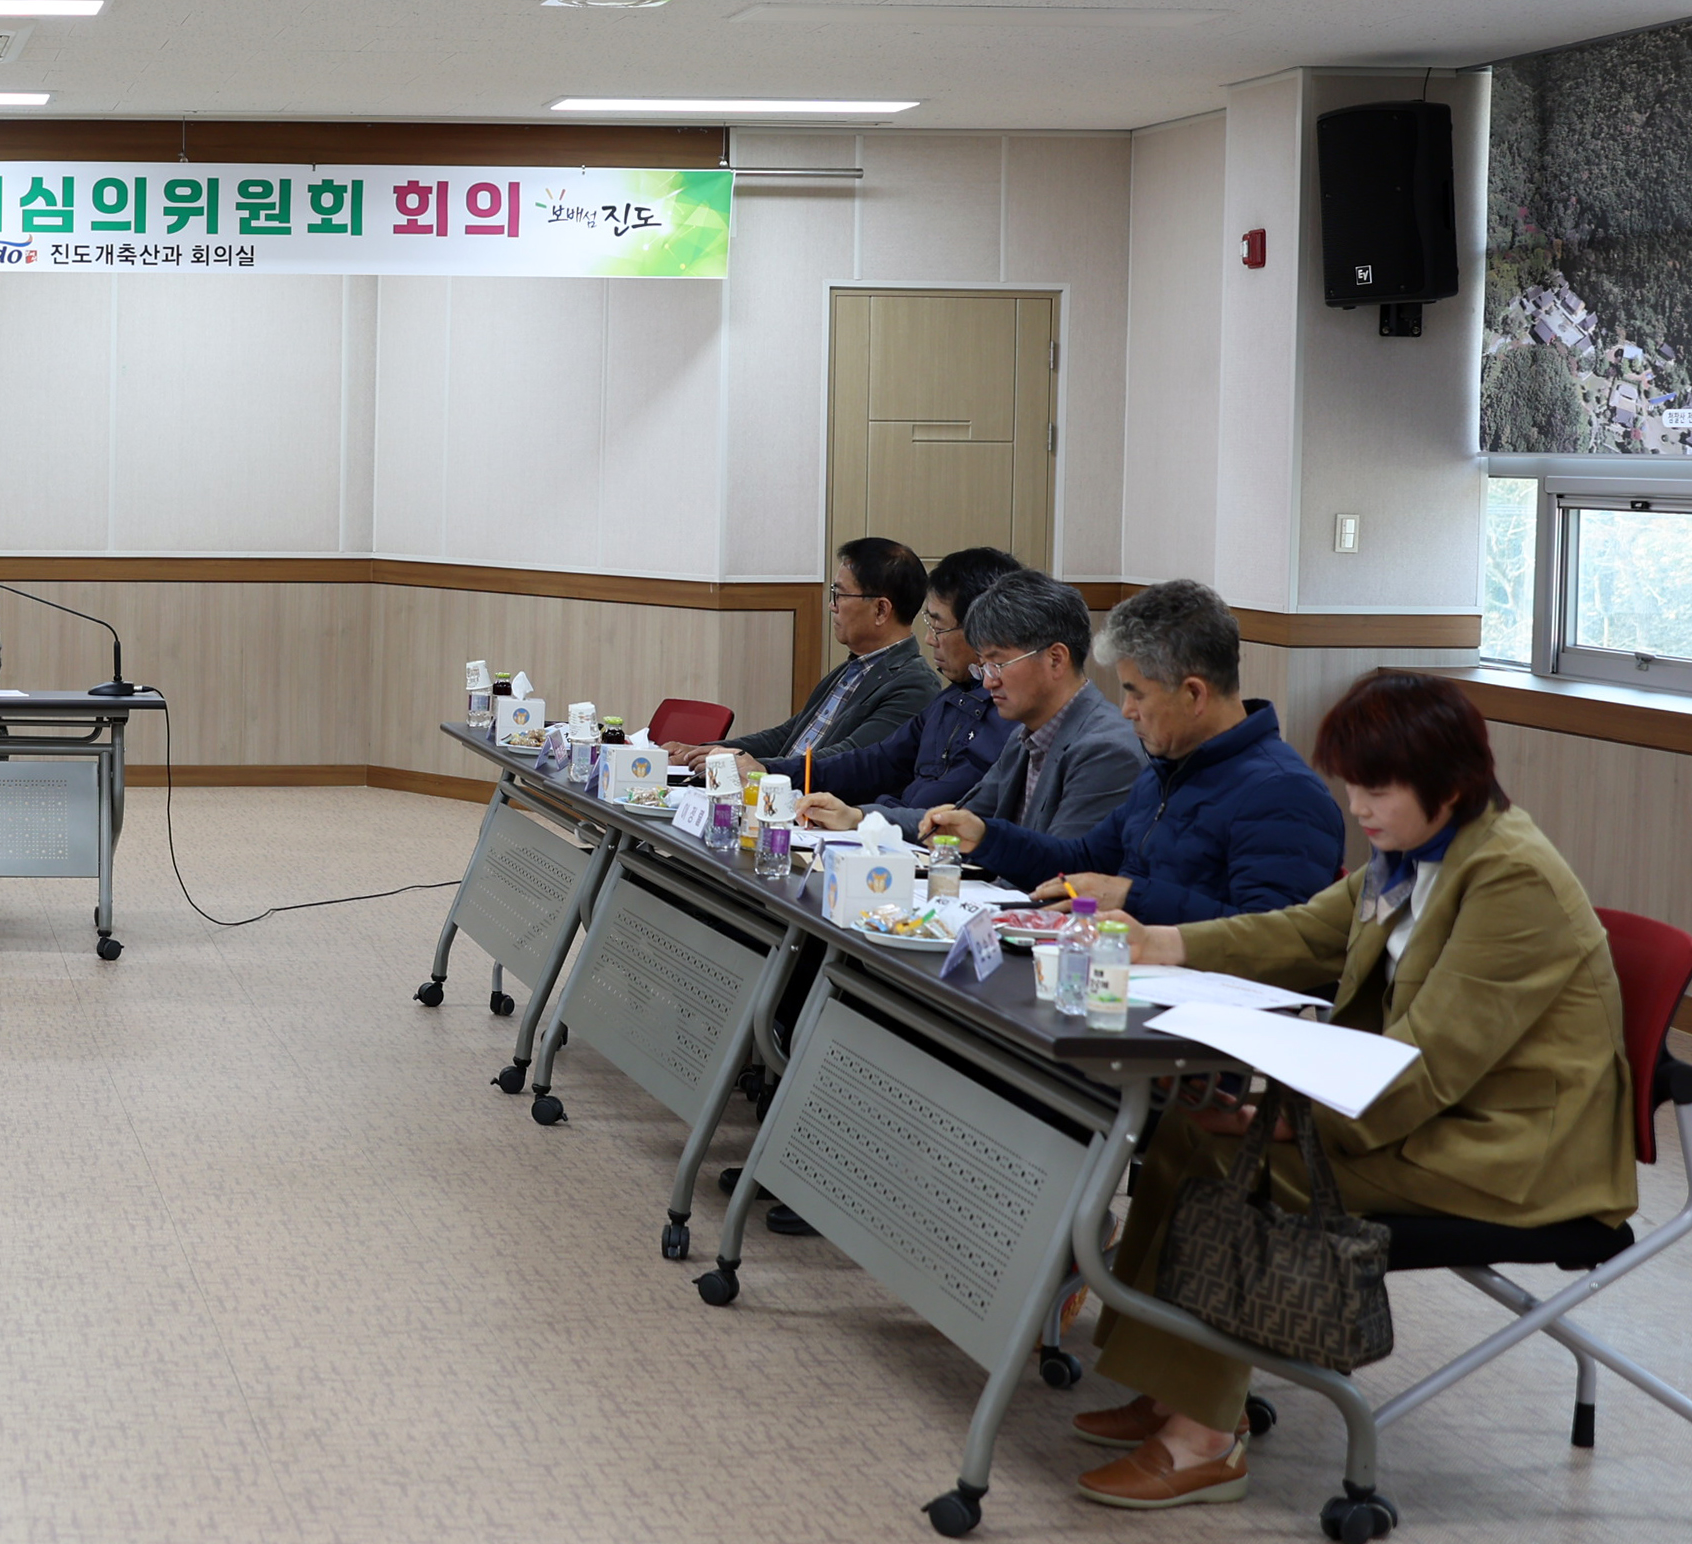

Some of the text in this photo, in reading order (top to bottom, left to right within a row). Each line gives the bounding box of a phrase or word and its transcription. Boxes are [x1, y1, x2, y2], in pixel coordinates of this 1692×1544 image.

[392, 180, 521, 237] 회의
[547, 203, 662, 237] 보배섬 진도
[51, 244, 183, 266] 진도개축산과
[190, 245, 255, 267] 회의실
